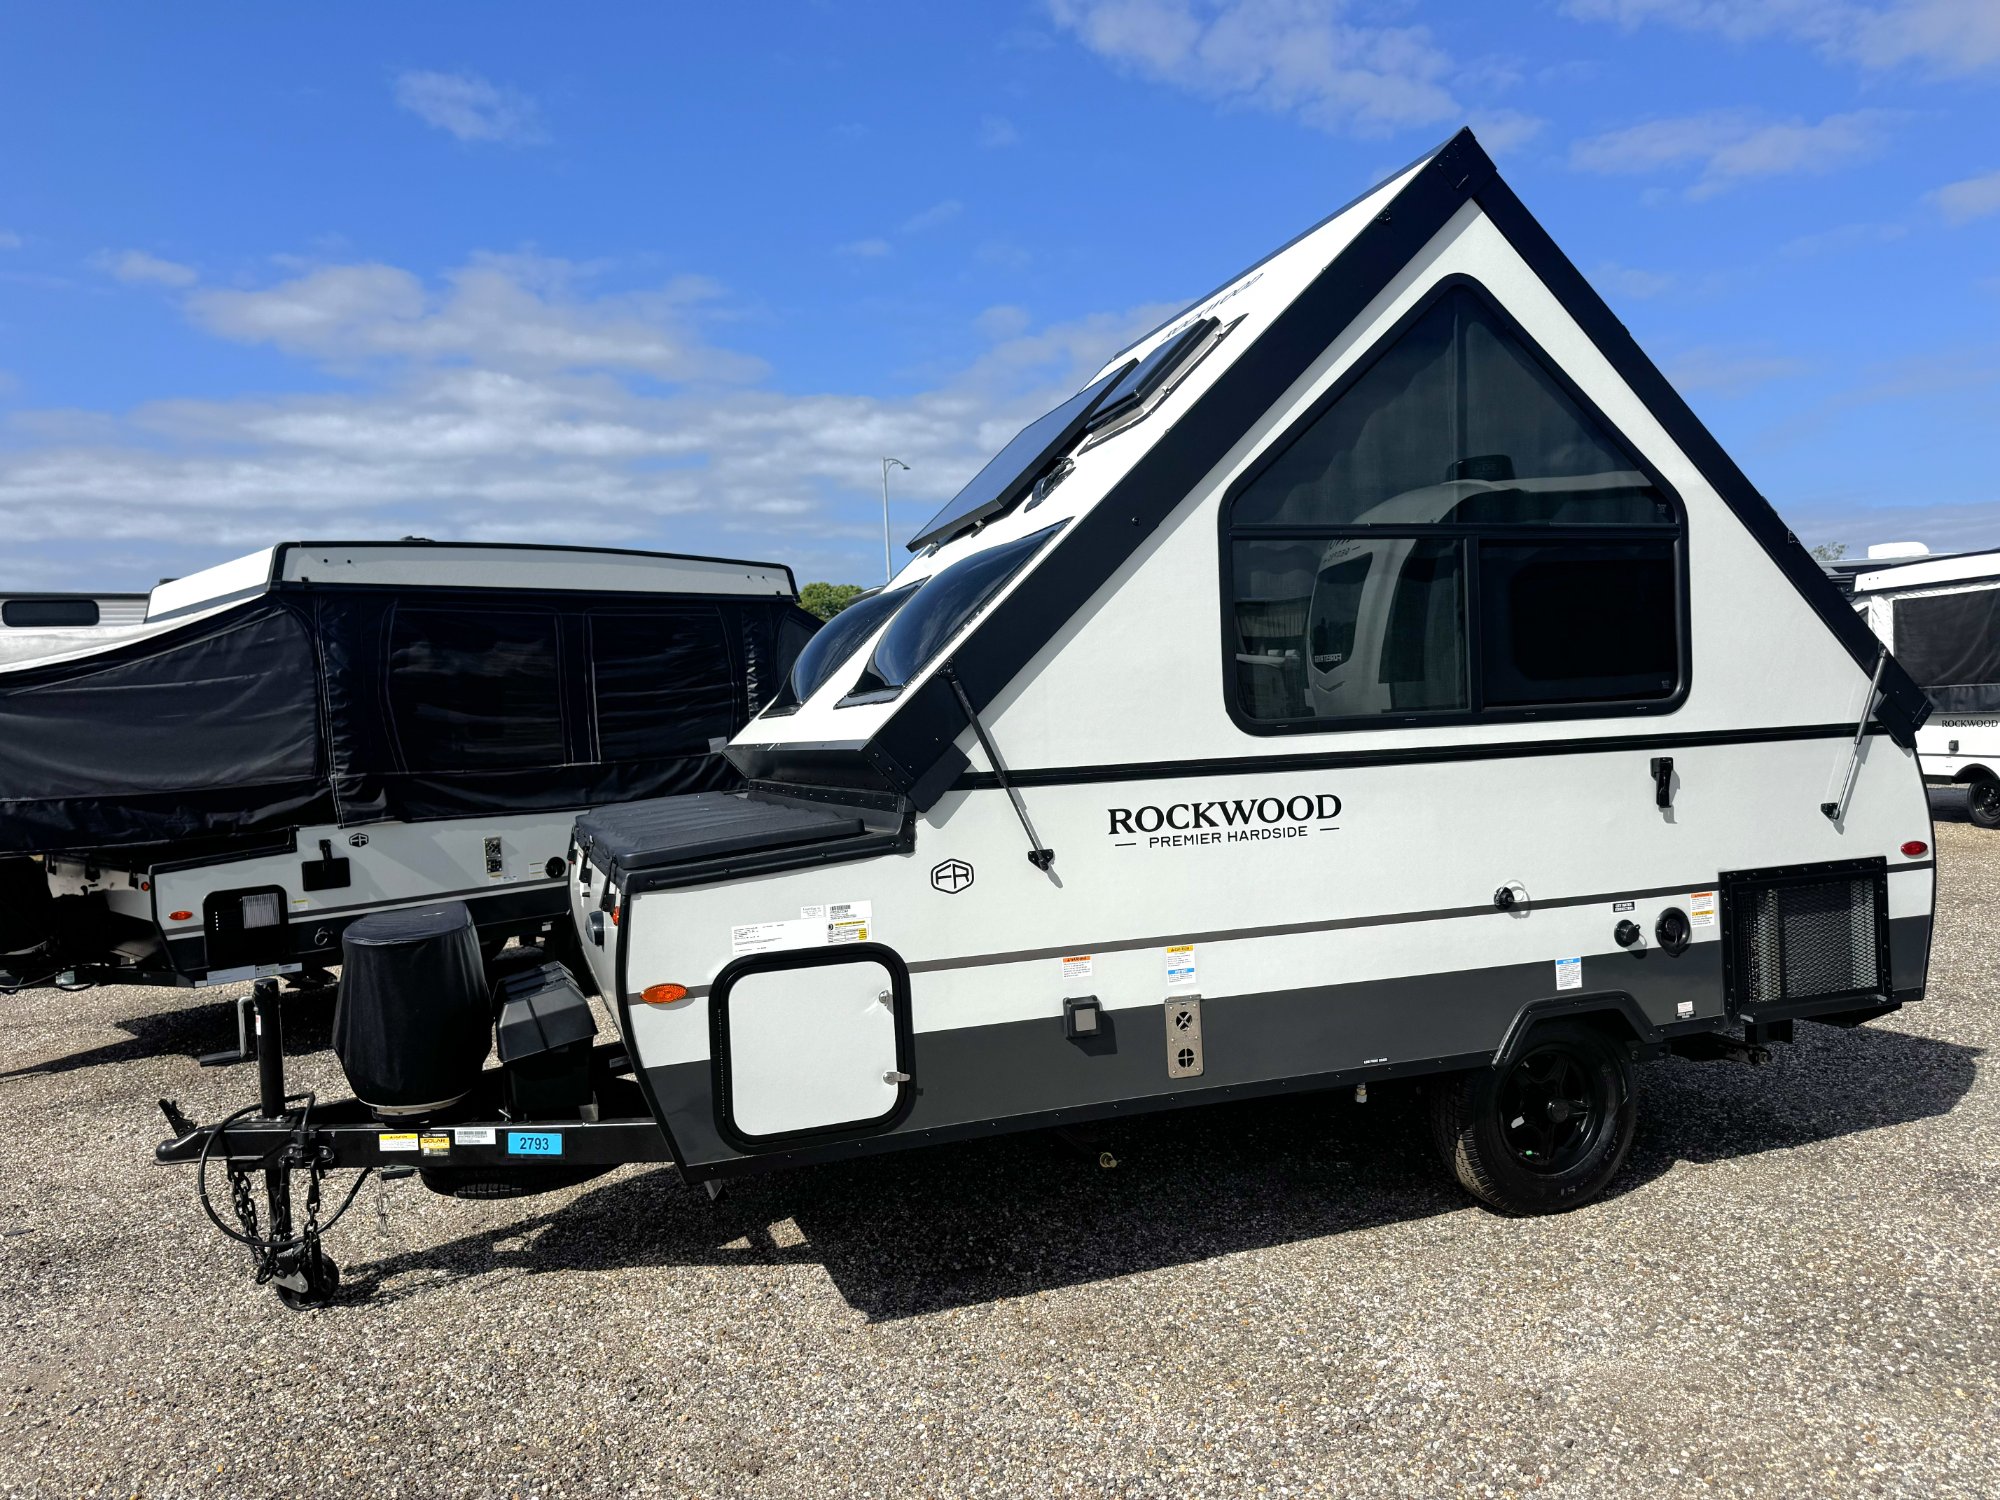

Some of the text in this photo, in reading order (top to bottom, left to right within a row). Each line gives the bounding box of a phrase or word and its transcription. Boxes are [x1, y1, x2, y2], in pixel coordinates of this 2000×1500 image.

[1941, 719, 1999, 728] ROCKWOOD
[1107, 793, 1342, 835] ROCKWOOD
[1149, 825, 1308, 848] PREMIER HARDSIDE
[519, 1136, 549, 1151] 2793
